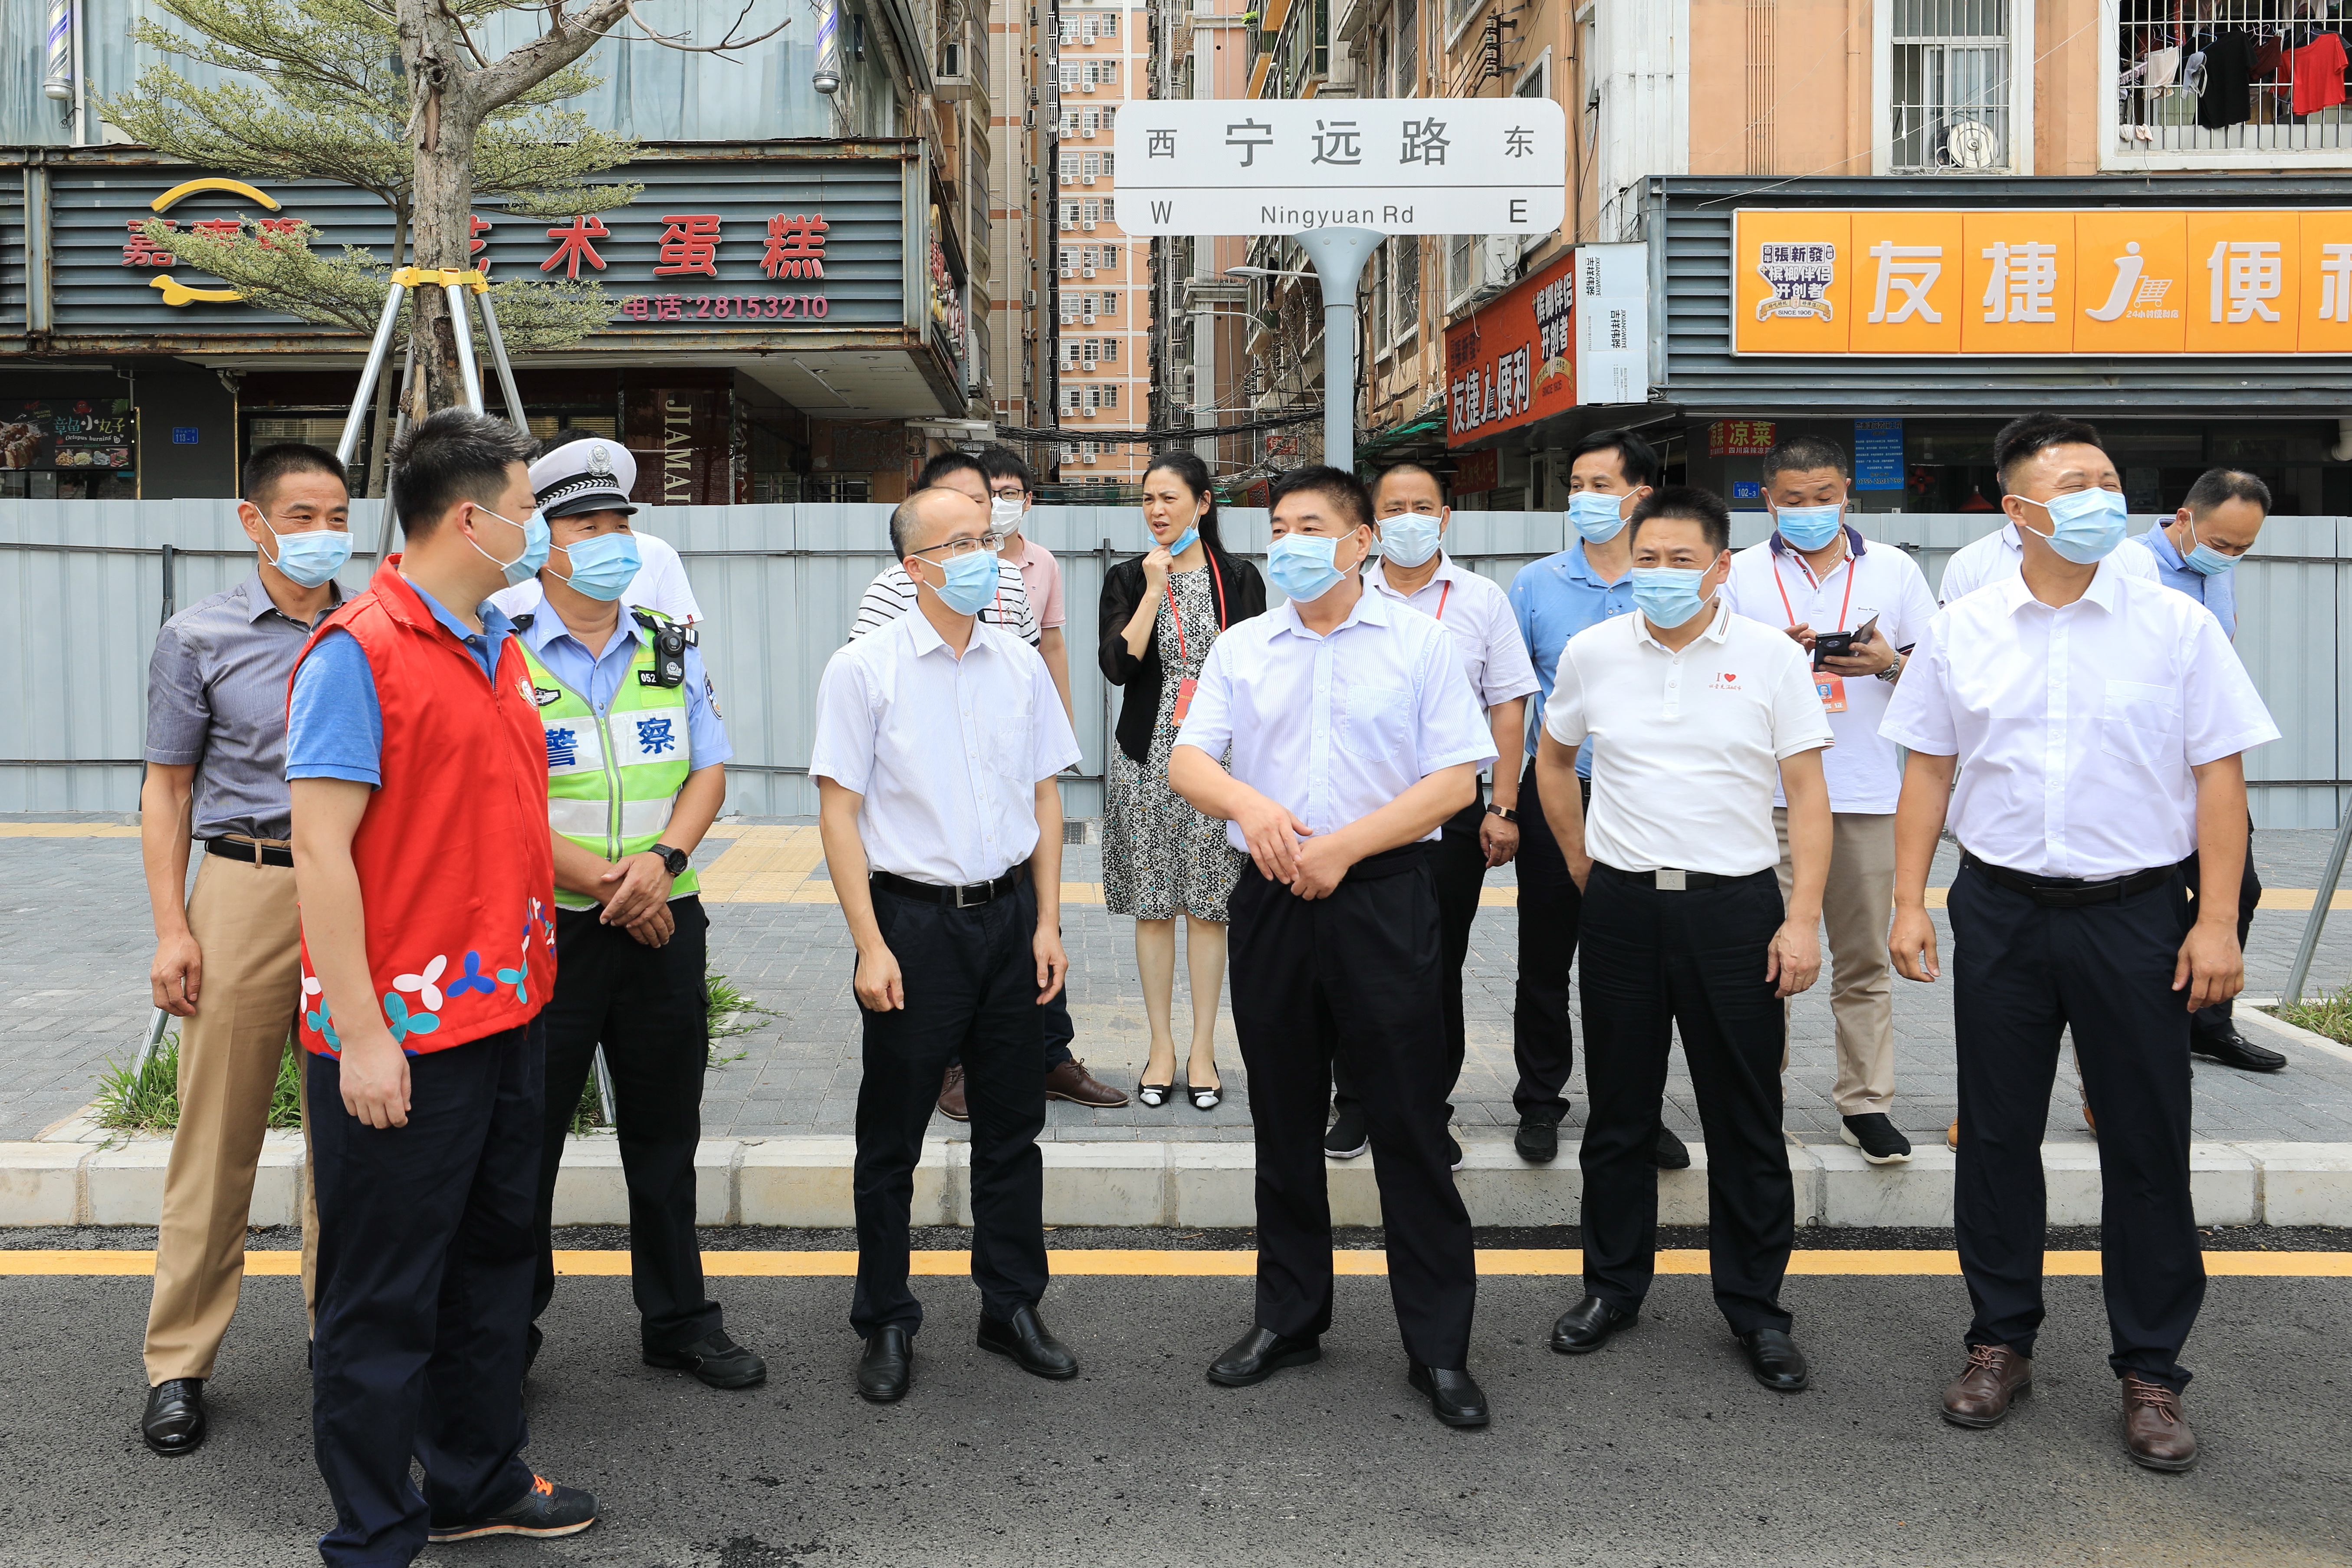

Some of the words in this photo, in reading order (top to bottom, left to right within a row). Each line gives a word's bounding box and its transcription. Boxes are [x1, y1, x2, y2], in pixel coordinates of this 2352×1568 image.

[1146, 129, 1177, 158] 西
[1225, 117, 1451, 167] 宁远路
[1504, 125, 1534, 158] 东
[1151, 201, 1172, 224] W
[1261, 205, 1373, 228] Ningyuan
[1383, 206, 1413, 223] Rd
[1509, 199, 1527, 222] E
[53, 415, 125, 435] 章鱼小丸子
[1729, 421, 1771, 446] 凉菜
[664, 400, 691, 506] JIAMAI
[1738, 488, 1756, 496] 102-3
[641, 673, 656, 683] 052
